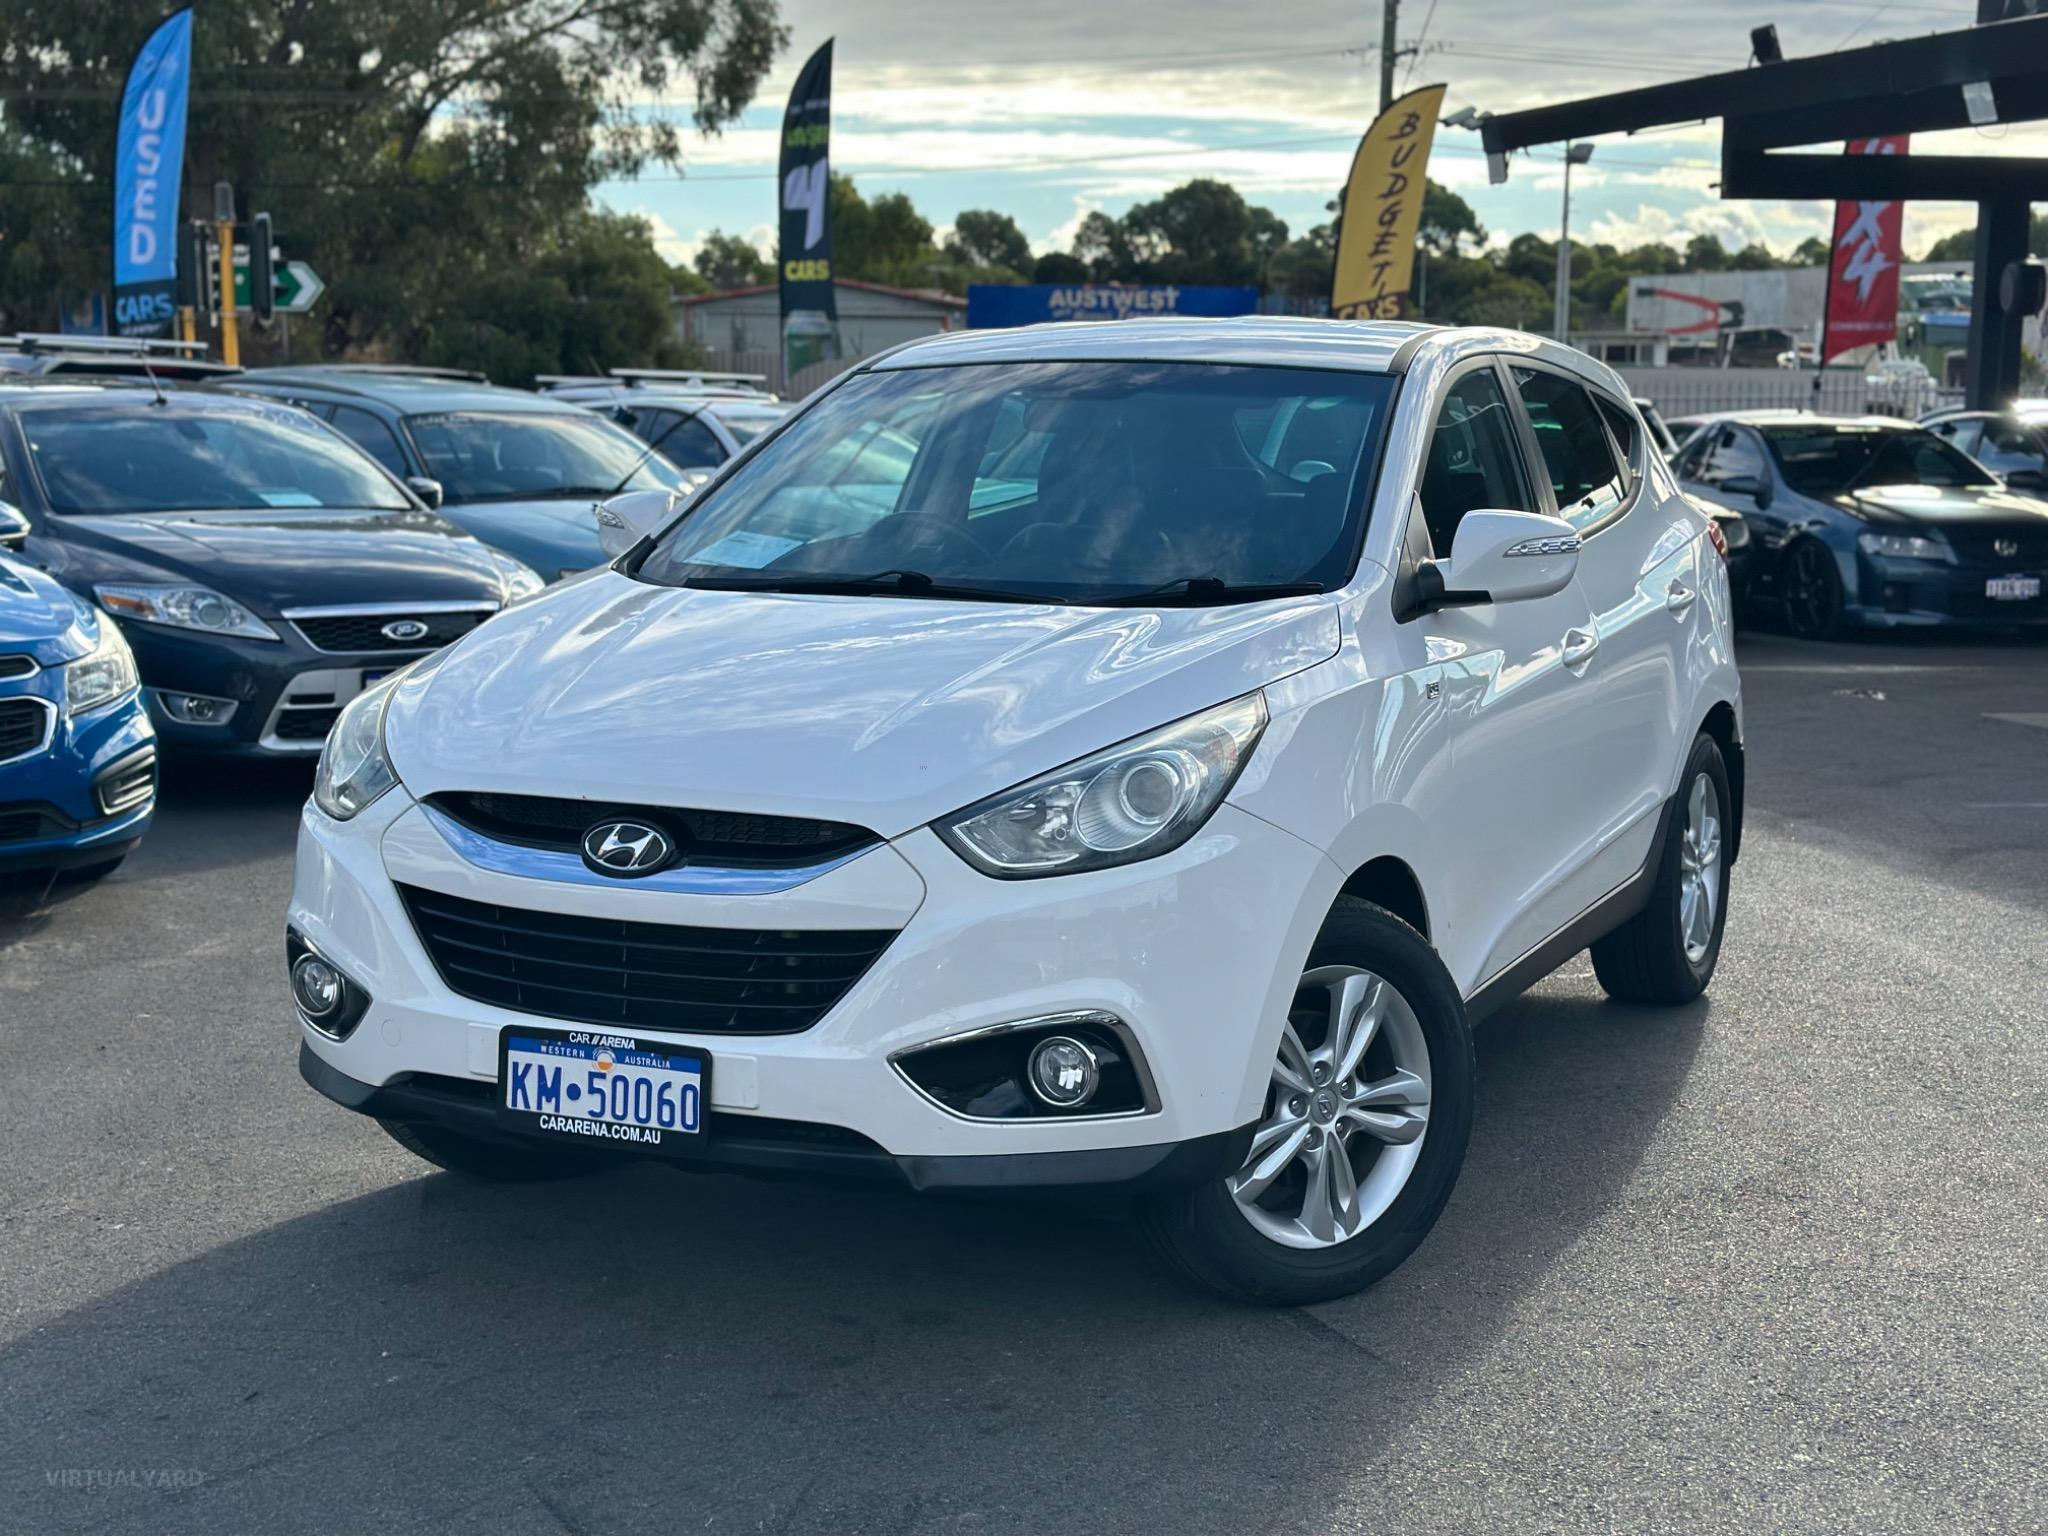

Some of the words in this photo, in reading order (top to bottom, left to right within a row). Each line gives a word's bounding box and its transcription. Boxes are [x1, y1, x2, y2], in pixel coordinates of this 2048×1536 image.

[129, 88, 166, 266] USED
[1368, 111, 1420, 287] BUDGET
[115, 292, 173, 324] CARS
[1050, 286, 1179, 308] AUSTWEST
[540, 1044, 586, 1059] WESTERN
[624, 1054, 672, 1070] AUSTRALIA
[539, 1114, 662, 1145] CARARENA.COM.AU
